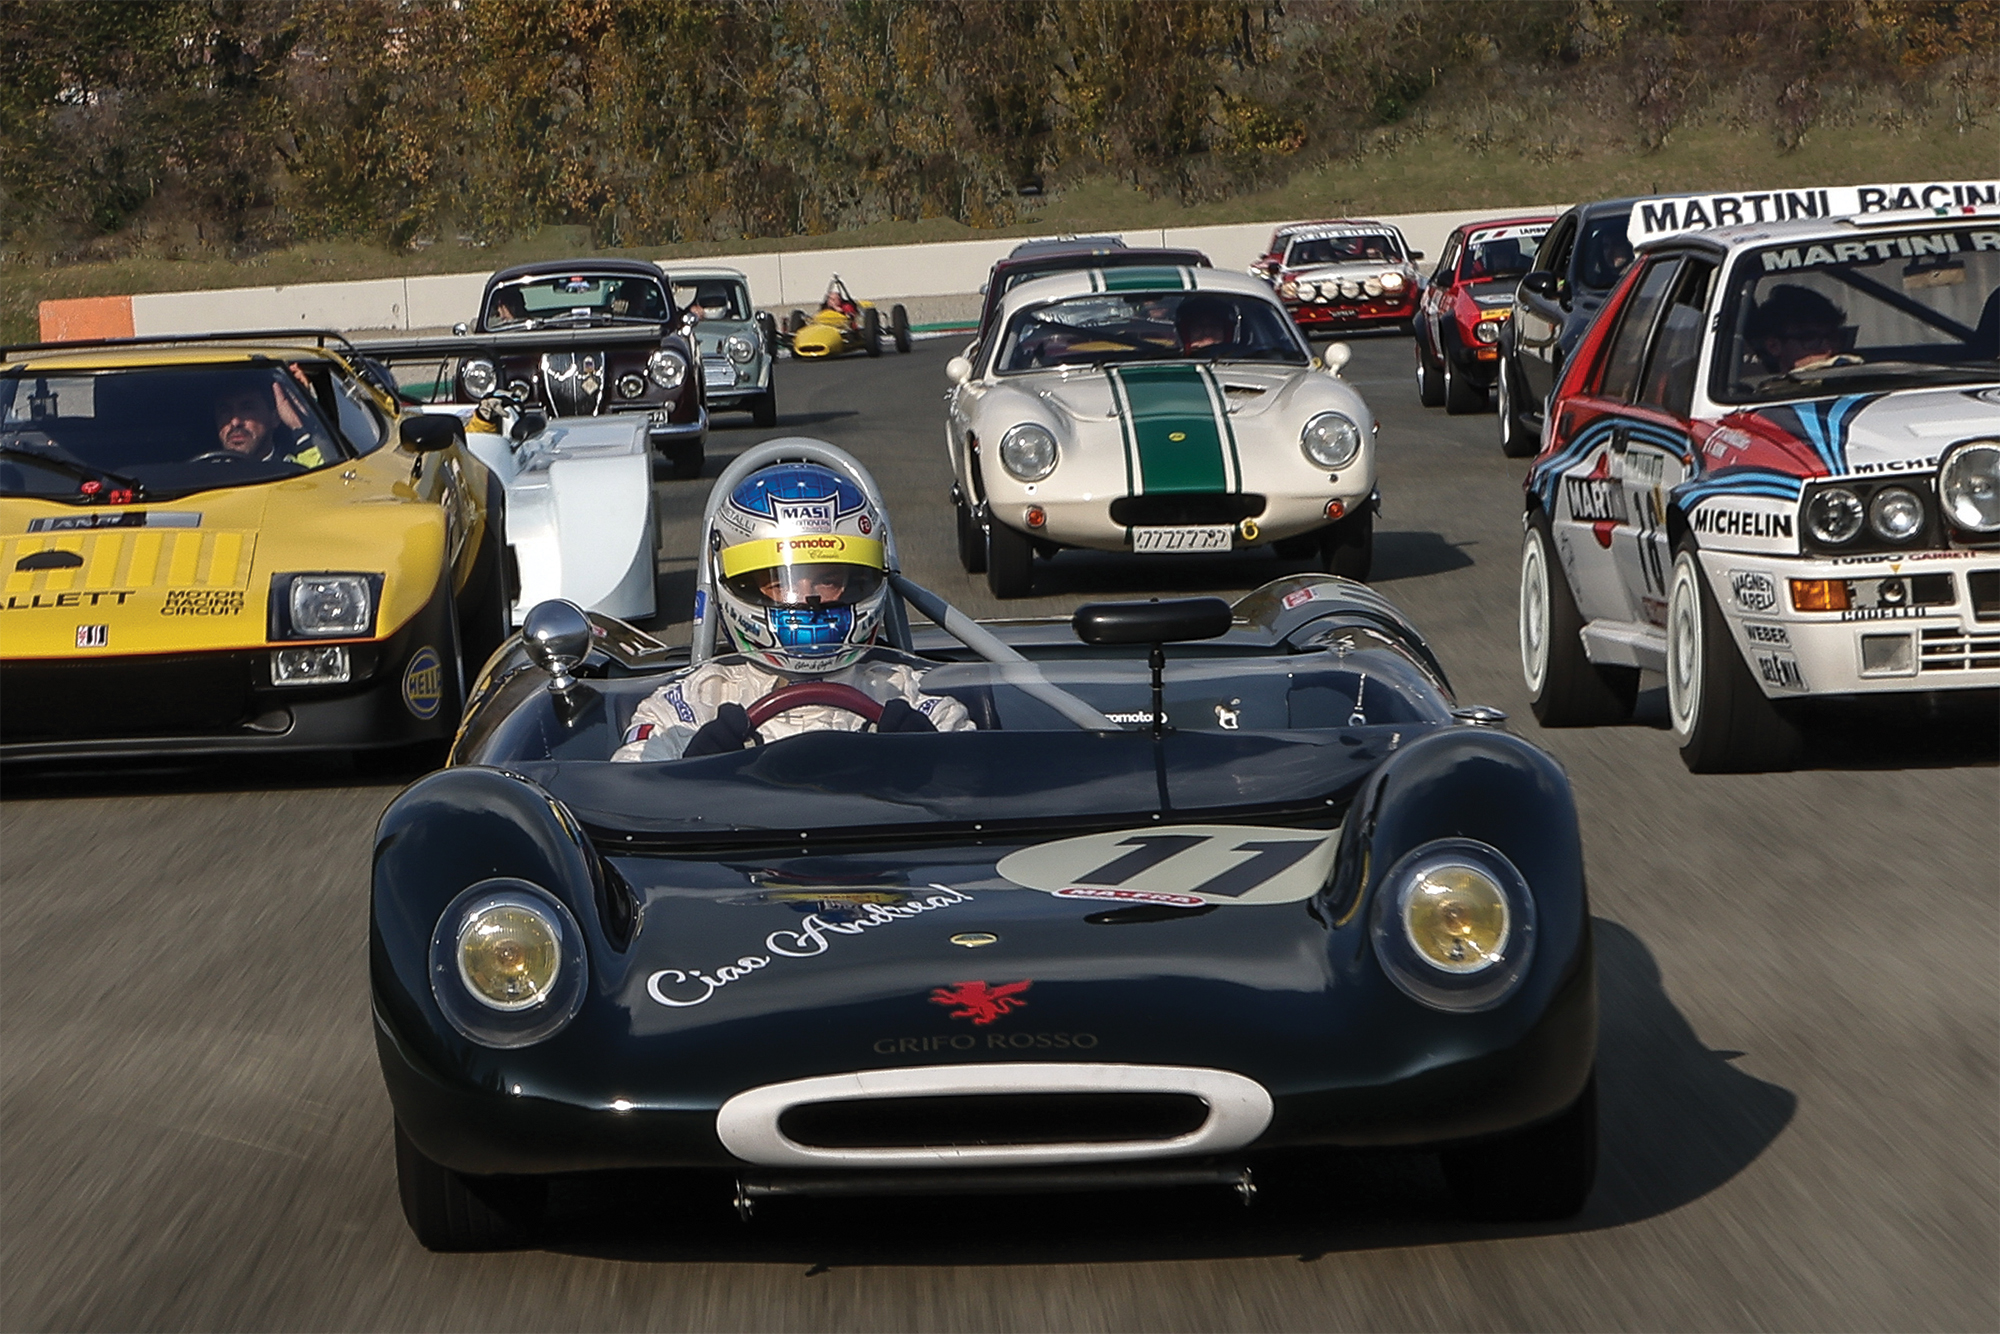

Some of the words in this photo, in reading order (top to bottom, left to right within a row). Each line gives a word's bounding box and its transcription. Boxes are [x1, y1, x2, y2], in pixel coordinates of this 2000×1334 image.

[1640, 189, 1830, 234] MARTINI
[1857, 185, 2000, 213] RACIN
[1760, 236, 1961, 271] MARTINI
[783, 507, 829, 519] MASI
[1694, 509, 1793, 538] MICHELIN
[0, 590, 137, 610] LLETT
[164, 598, 245, 608] RACING
[168, 590, 244, 600] MOTOR
[160, 607, 242, 617] CIRCUIT
[1744, 624, 1790, 643] WEBER
[1070, 834, 1330, 898] 11
[646, 955, 770, 1007] Ciao
[872, 1035, 976, 1055] GRIFO
[986, 1032, 1099, 1050] ROSSO
